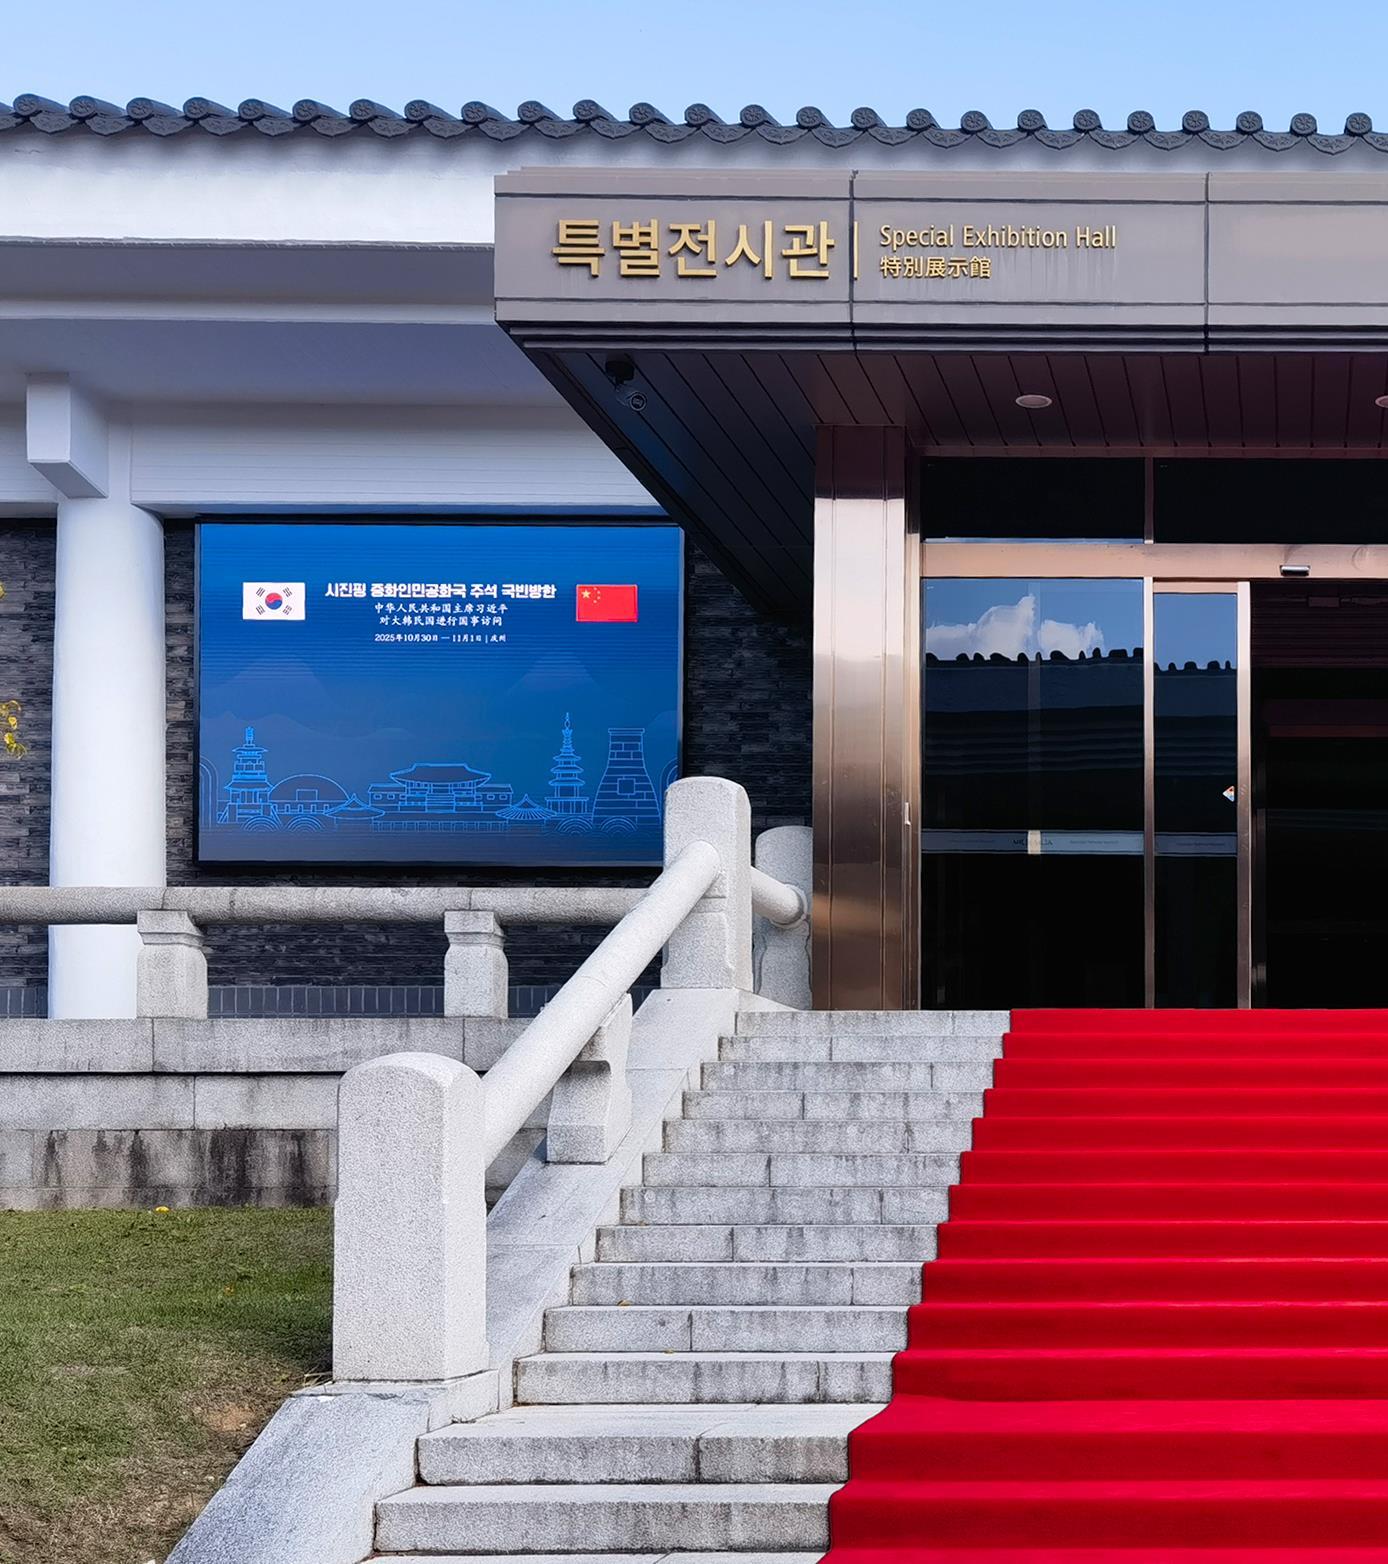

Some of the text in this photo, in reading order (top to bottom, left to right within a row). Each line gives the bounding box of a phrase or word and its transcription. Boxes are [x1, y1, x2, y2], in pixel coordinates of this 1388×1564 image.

[880, 224, 1117, 253] Special Exhibition Hall
[552, 218, 836, 280] 특별전시관
[880, 256, 992, 279] 特別展示館
[325, 582, 557, 599] 시진핑 중화인민공화국 주석 국빈방한
[374, 602, 509, 614] 中华人民共和国主席习近平
[379, 614, 503, 627] 对大韩民国进行国事访问
